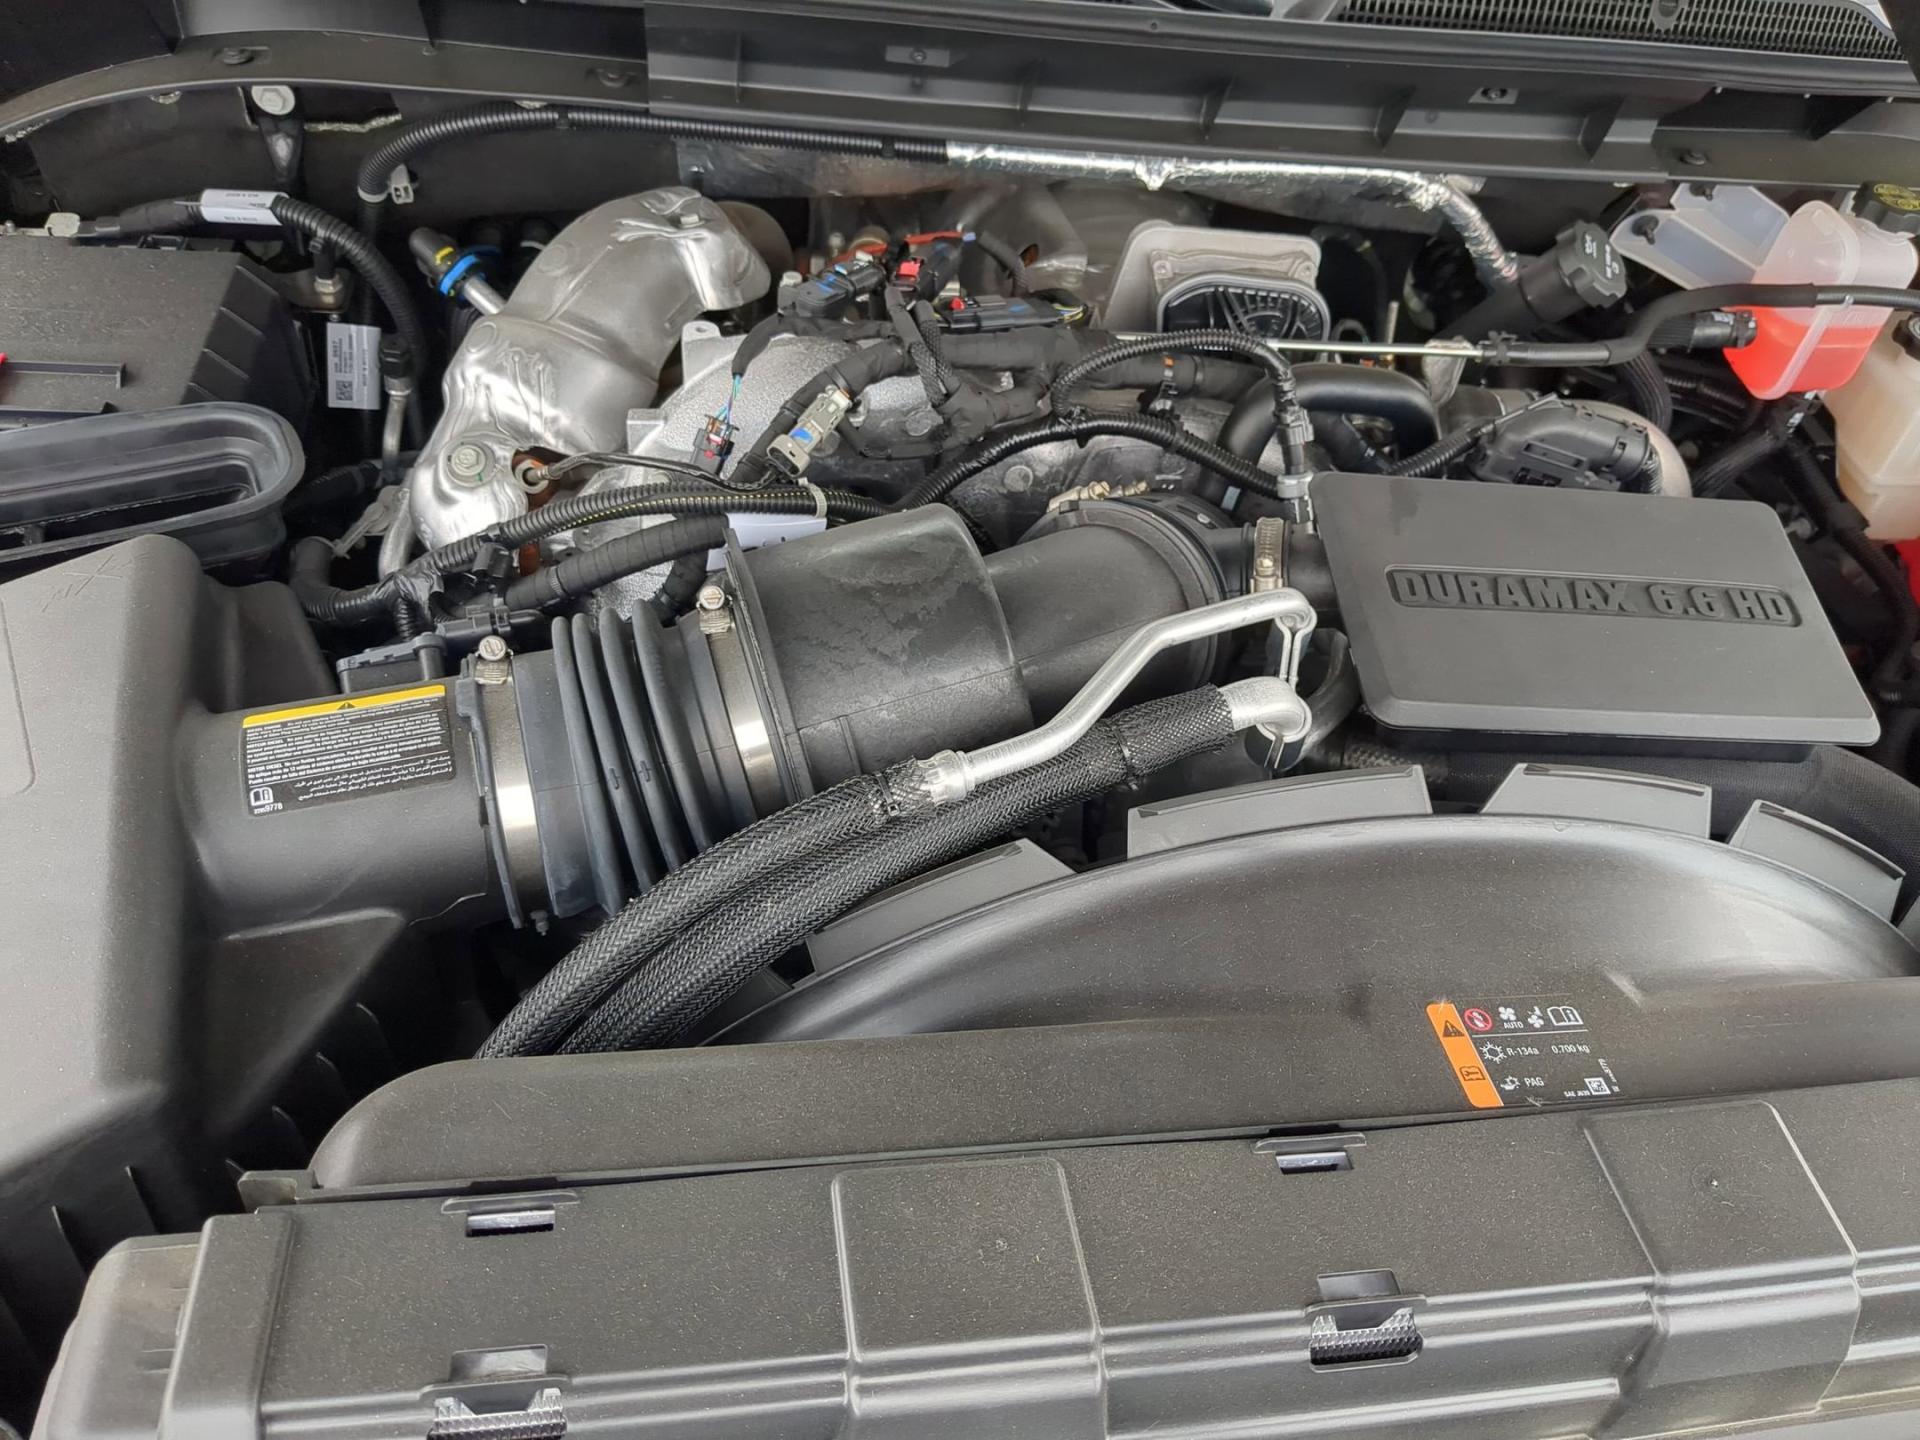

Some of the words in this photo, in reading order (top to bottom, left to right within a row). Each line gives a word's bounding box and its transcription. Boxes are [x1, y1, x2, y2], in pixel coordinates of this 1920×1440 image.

[1395, 572, 1637, 613] DURAMAX
[1648, 584, 1724, 617] 6.6
[1727, 588, 1793, 620] HD
[1503, 1021, 1524, 1029] AUTO
[1524, 1077, 1545, 1087] PAG
